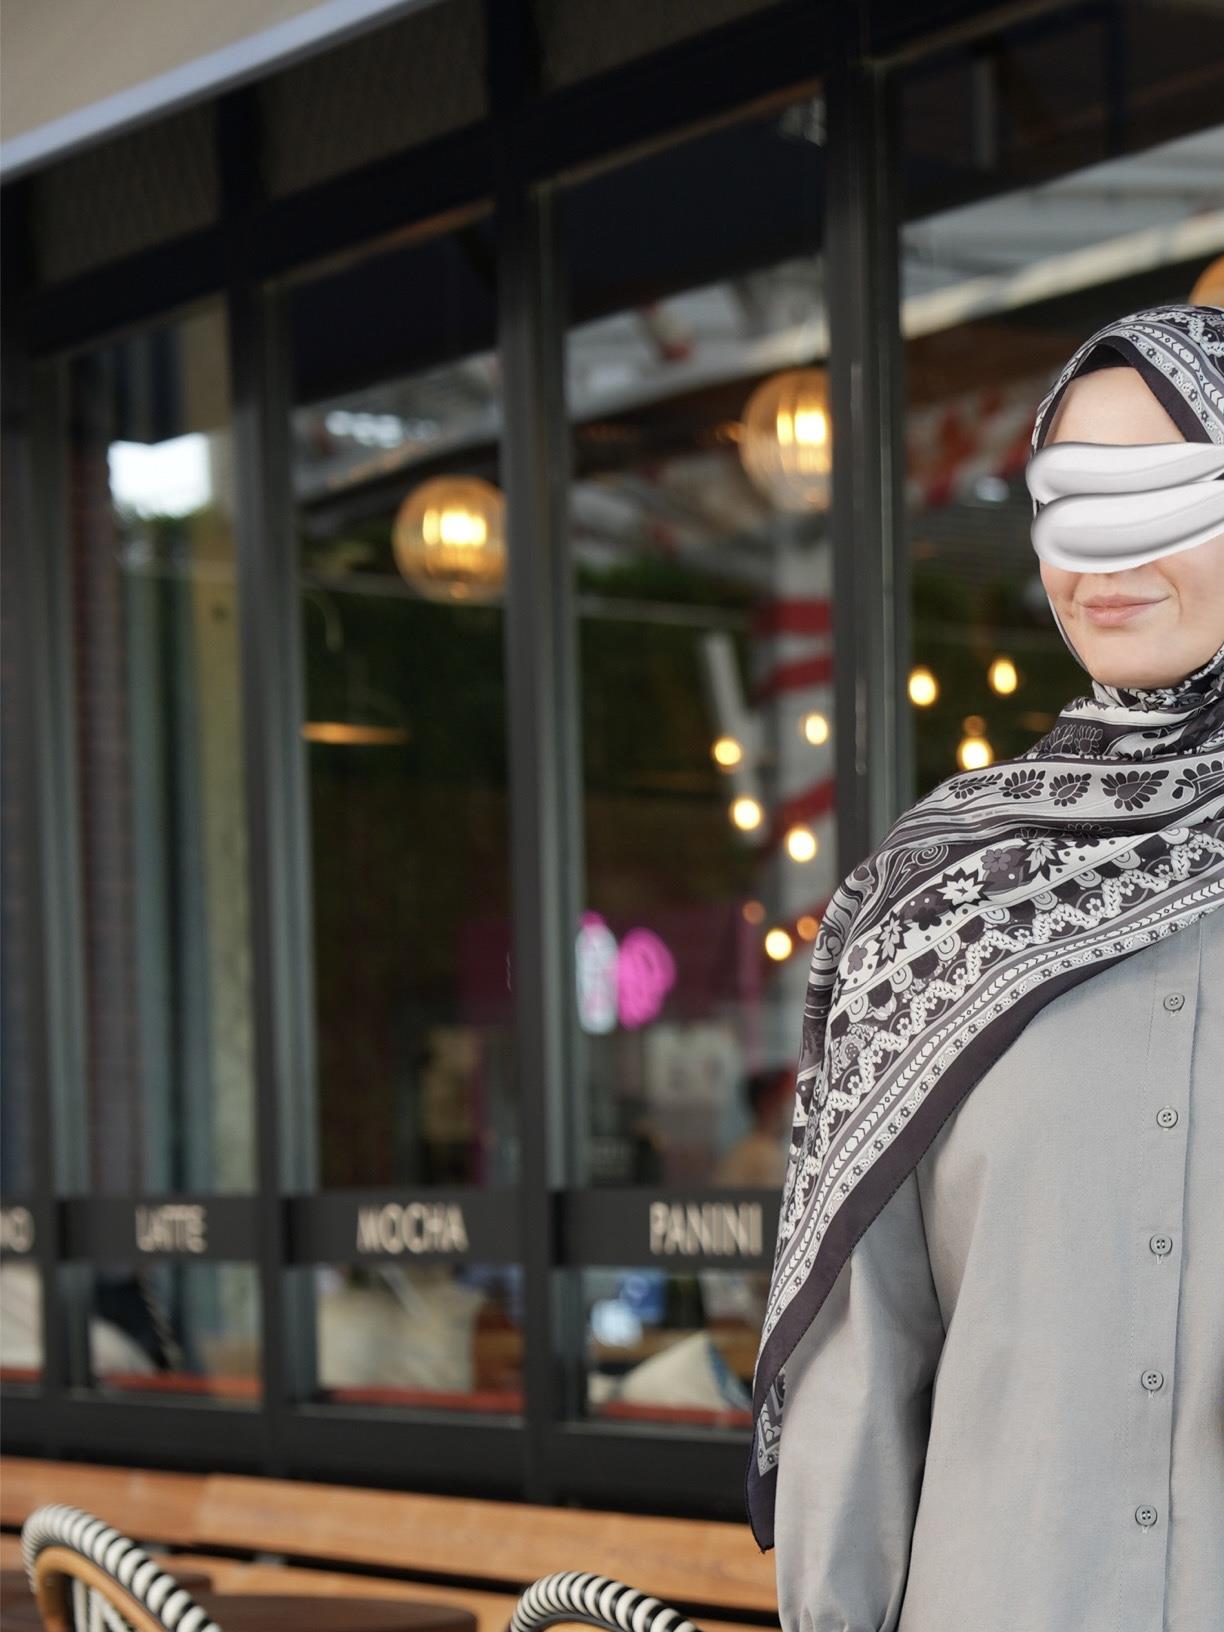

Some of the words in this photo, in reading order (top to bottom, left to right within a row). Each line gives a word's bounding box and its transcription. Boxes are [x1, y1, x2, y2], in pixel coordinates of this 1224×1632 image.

[136, 1204, 207, 1252] LATTE
[357, 1202, 468, 1254] MOCHA
[649, 1201, 762, 1256] PANINI
